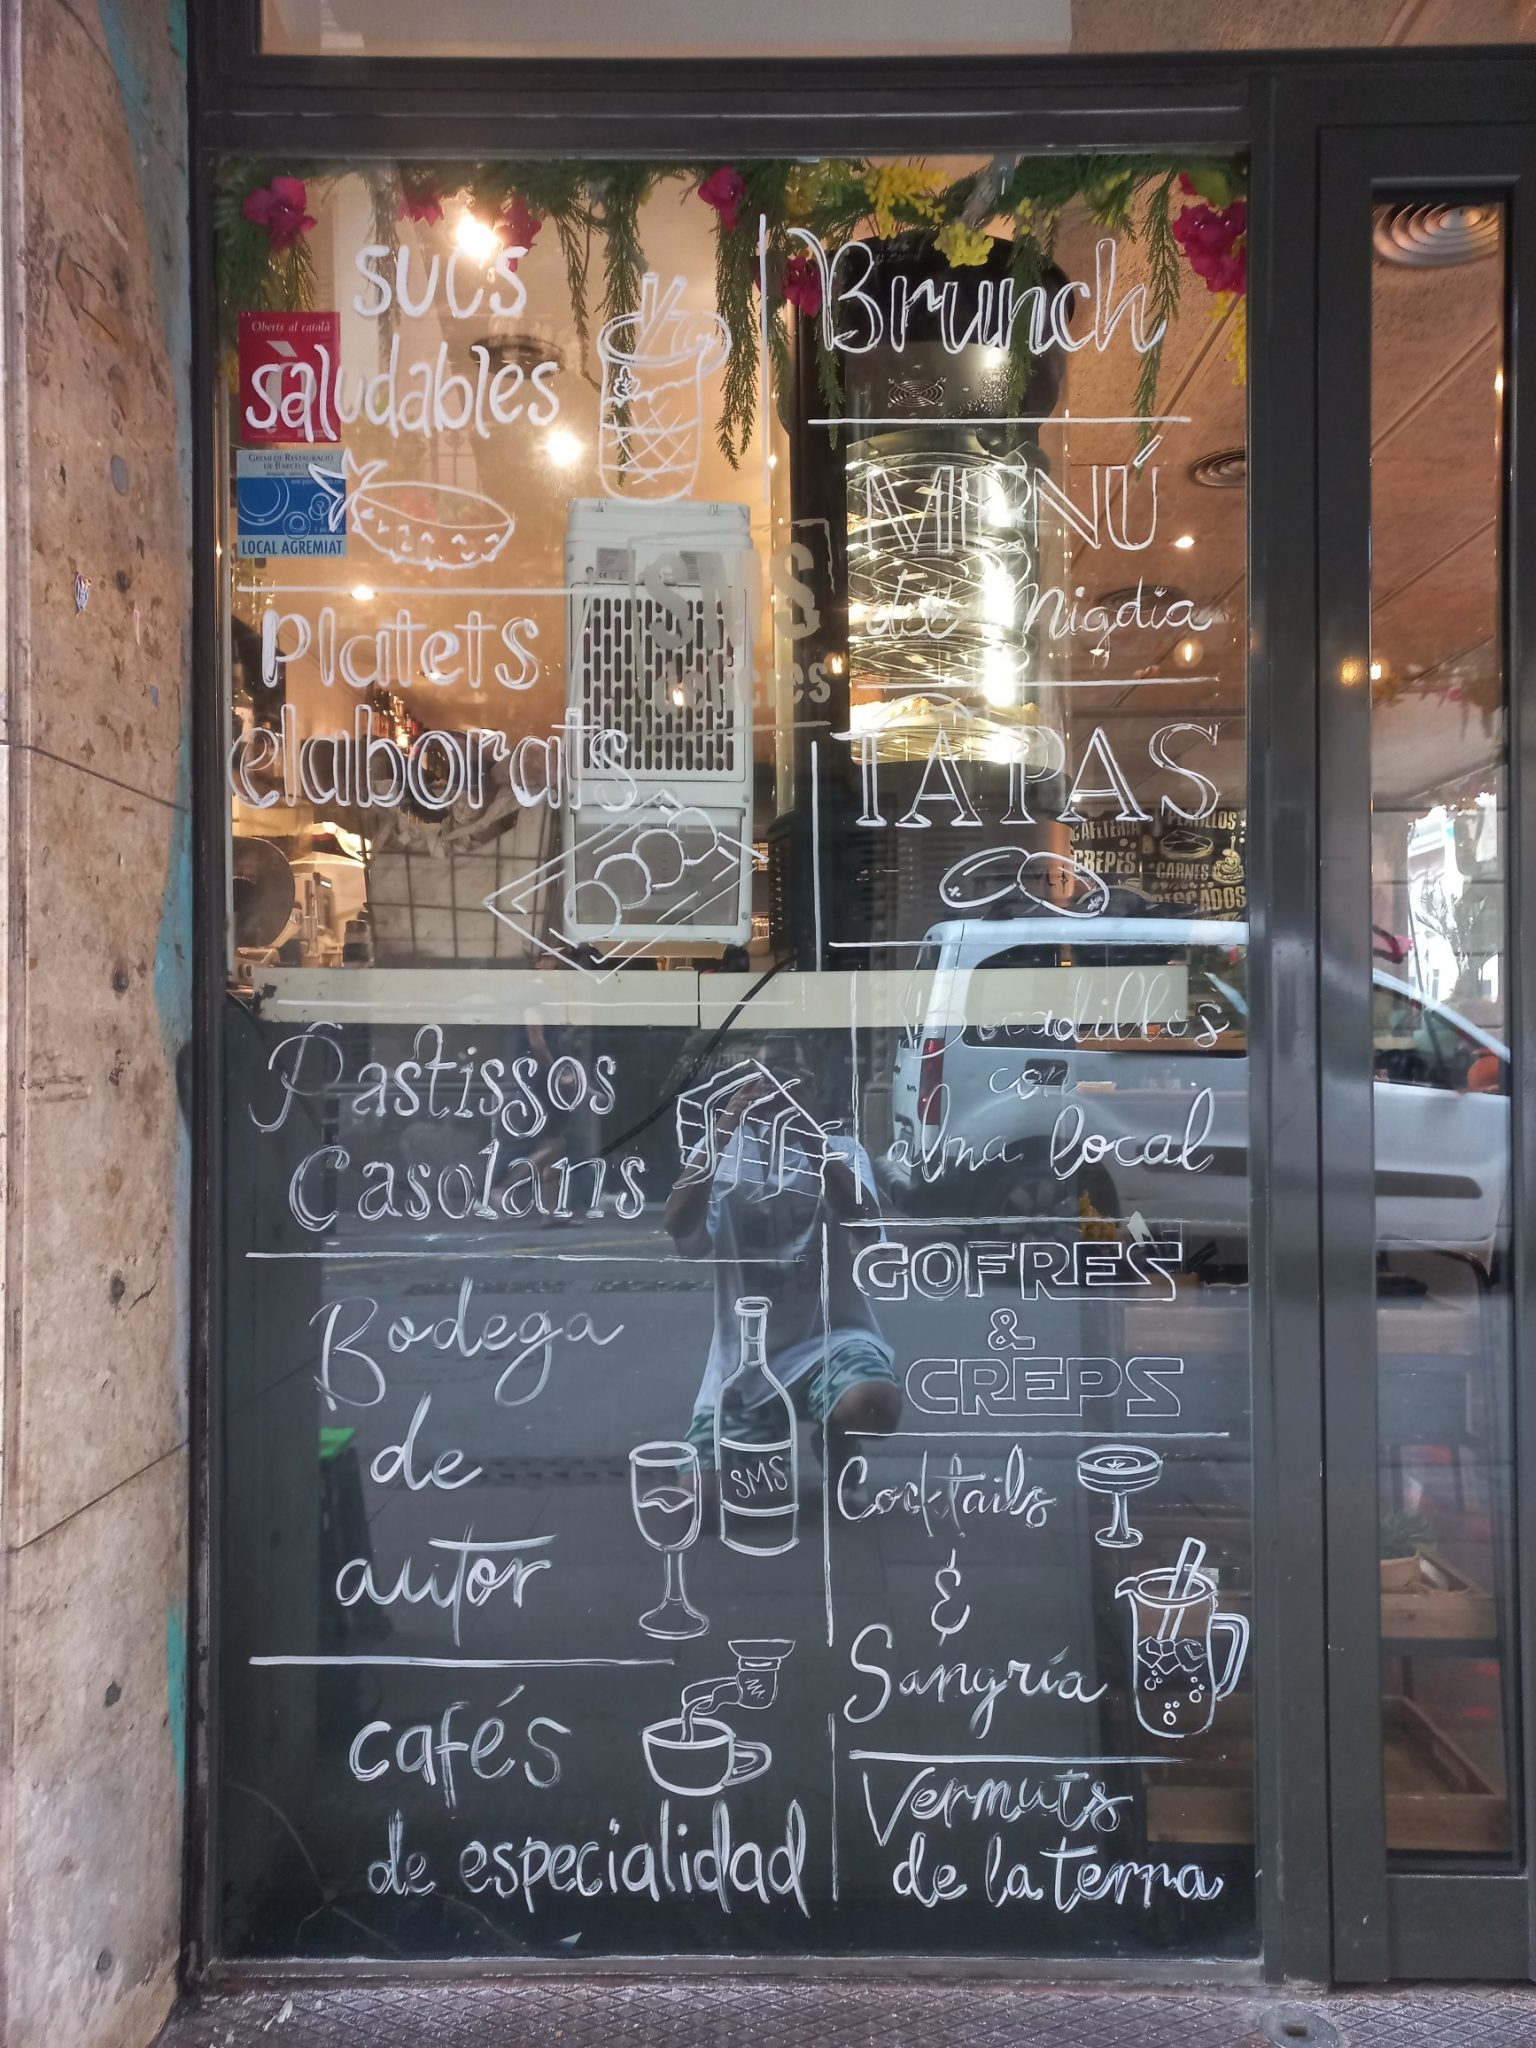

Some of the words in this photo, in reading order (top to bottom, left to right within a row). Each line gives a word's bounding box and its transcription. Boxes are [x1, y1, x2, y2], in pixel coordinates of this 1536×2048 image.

[252, 321, 284, 332] Oberts
[288, 321, 298, 331] al
[301, 321, 330, 332] català
[787, 227, 1167, 354] Brunch
[245, 335, 560, 442] saludables
[866, 435, 1163, 553] MENÚ
[242, 540, 277, 555] LOCAL
[281, 540, 343, 555] AGREMIAT
[641, 542, 821, 650] SMS
[229, 704, 637, 810] elaborats
[831, 693, 1221, 828] TAPAS
[1073, 849, 1137, 874] CREPES
[1156, 861, 1209, 881] CARNES
[897, 970, 1230, 1058] Bocadillos
[249, 1022, 617, 1137] Pastissos
[989, 1067, 1081, 1099] con
[887, 1084, 1025, 1183] alma
[1051, 1087, 1215, 1181] local
[289, 1138, 647, 1231] Casolans
[852, 1241, 1184, 1301] GOFRES
[309, 1276, 624, 1411] Bodega
[988, 1308, 1036, 1350] &
[905, 1357, 1184, 1417] CREPS
[370, 1392, 483, 1491] de
[730, 1455, 788, 1498] SMS
[837, 1443, 1058, 1538] Cocktails
[335, 1523, 559, 1647] autor
[843, 1623, 1108, 1740] Sangría
[349, 1684, 573, 1809] cafés
[863, 1767, 1133, 1846] Vermuts
[367, 1808, 437, 1895] de
[459, 1799, 811, 1918] especialidad
[893, 1832, 968, 1907] de
[985, 1832, 1044, 1908] la
[1039, 1837, 1223, 1913] terra
